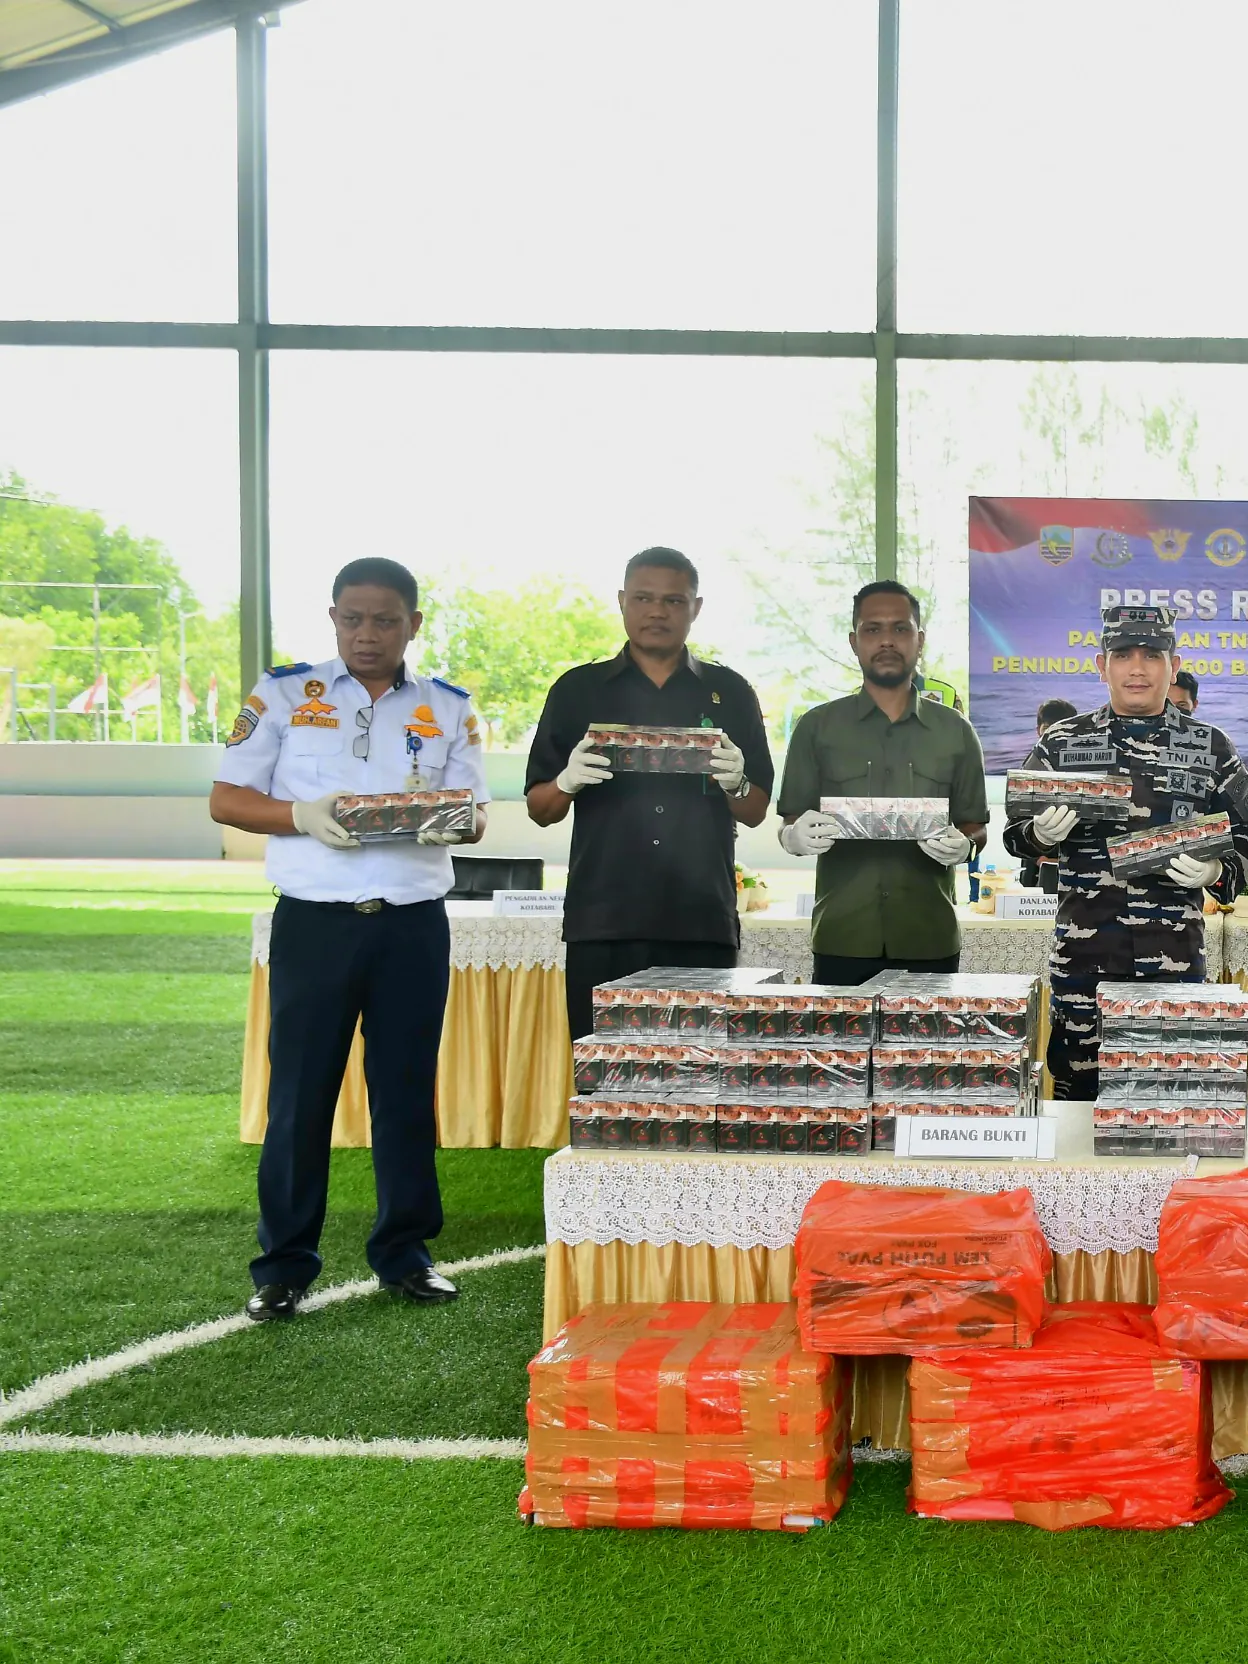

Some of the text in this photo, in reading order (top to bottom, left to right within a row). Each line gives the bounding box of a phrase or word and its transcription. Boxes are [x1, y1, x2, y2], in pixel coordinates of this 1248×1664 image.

[1101, 588, 1217, 621] PRESS
[993, 657, 1099, 675] PENINDA
[1183, 659, 1224, 676] 600
[1166, 752, 1211, 766] TNI AL
[1020, 897, 1058, 905] DANLANA
[1018, 908, 1058, 917] KOTABAR
[921, 1128, 1027, 1143] BARANG BUKTI
[890, 1251, 947, 1266] PUTIH
[954, 1251, 990, 1266] LEM
